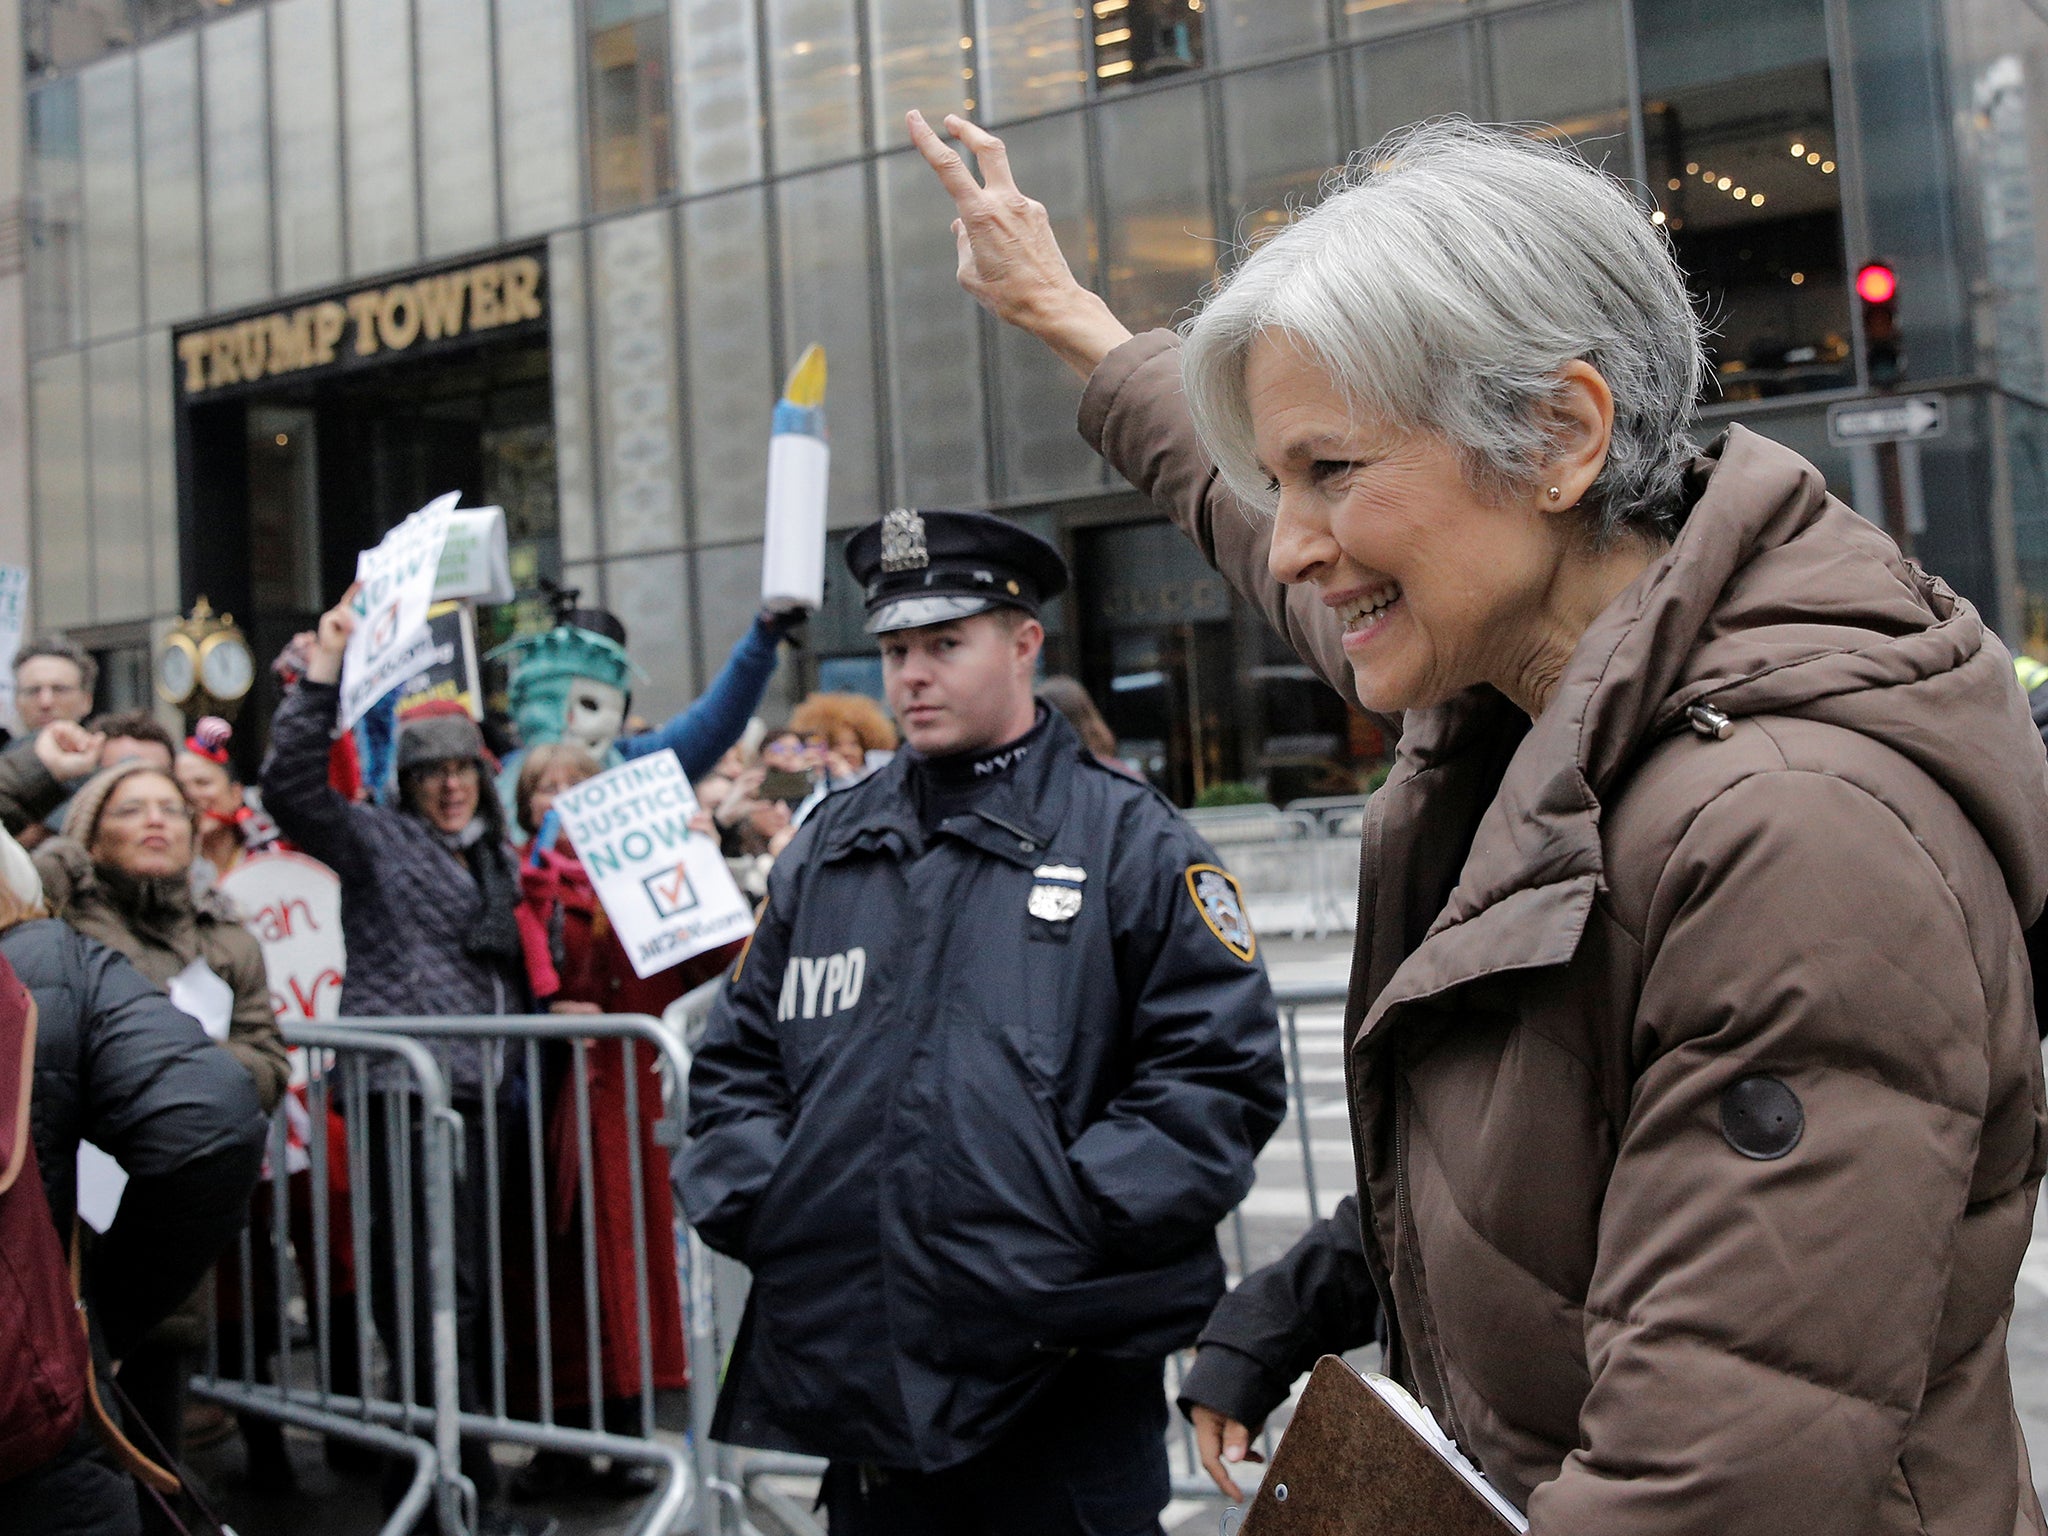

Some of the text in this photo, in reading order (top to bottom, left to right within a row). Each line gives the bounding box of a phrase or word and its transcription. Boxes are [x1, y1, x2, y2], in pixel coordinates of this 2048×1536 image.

[178, 256, 542, 393] TRUMP TOWER
[561, 757, 676, 815] VOTING
[574, 786, 692, 845] JUSTICE
[587, 812, 692, 879] NOW
[777, 946, 866, 1022] NYPD
